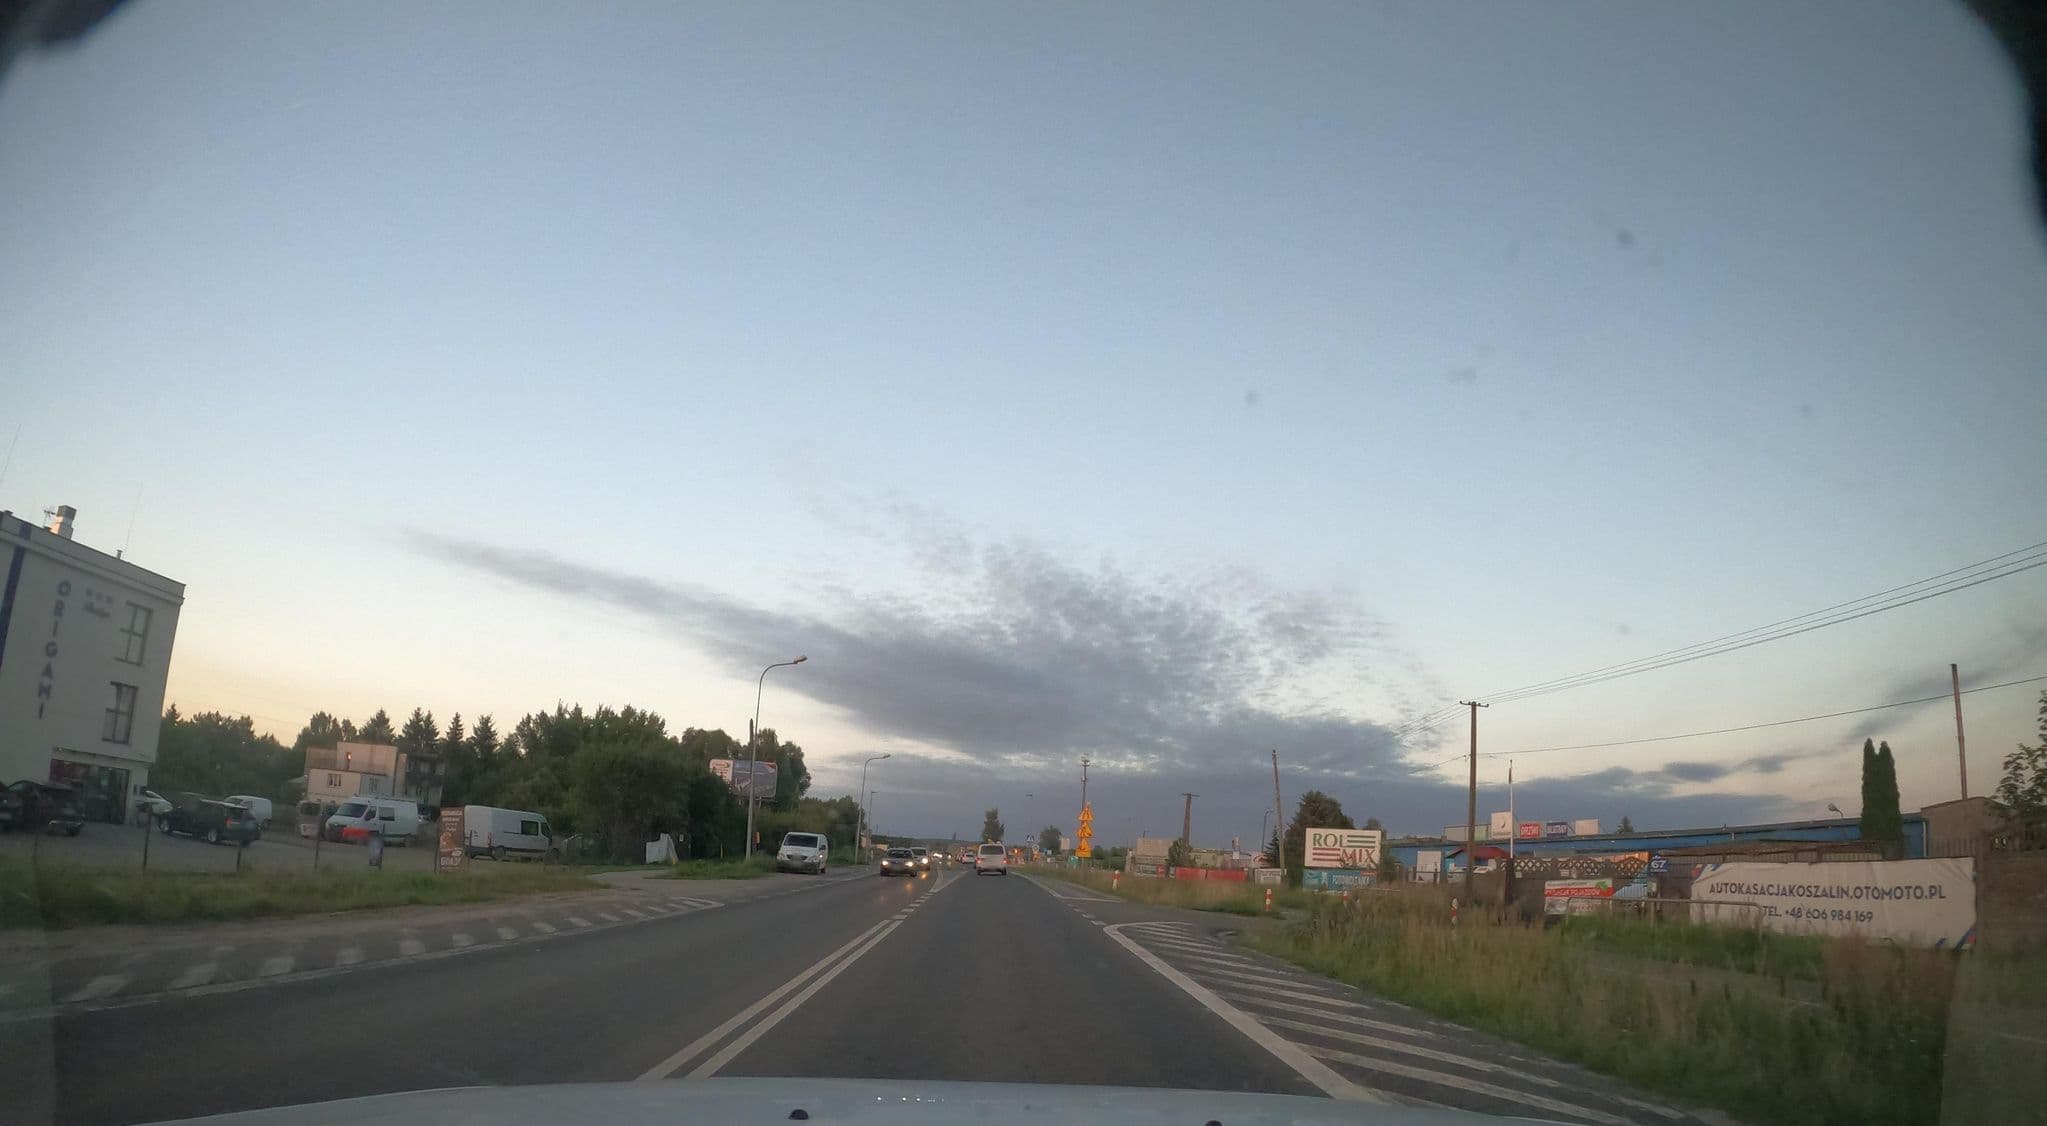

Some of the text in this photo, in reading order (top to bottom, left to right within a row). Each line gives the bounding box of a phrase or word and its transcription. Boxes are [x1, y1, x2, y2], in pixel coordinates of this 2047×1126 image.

[38, 580, 71, 720] ORIGAMI
[1312, 833, 1346, 847] ROL
[1341, 848, 1377, 866] MIX
[1651, 860, 1667, 869] 67
[1709, 882, 1946, 901] AUTOKASACJAKOSZALIN.OTOMOTO.PL
[1764, 906, 1873, 922] TEL. +48 606 984 169
